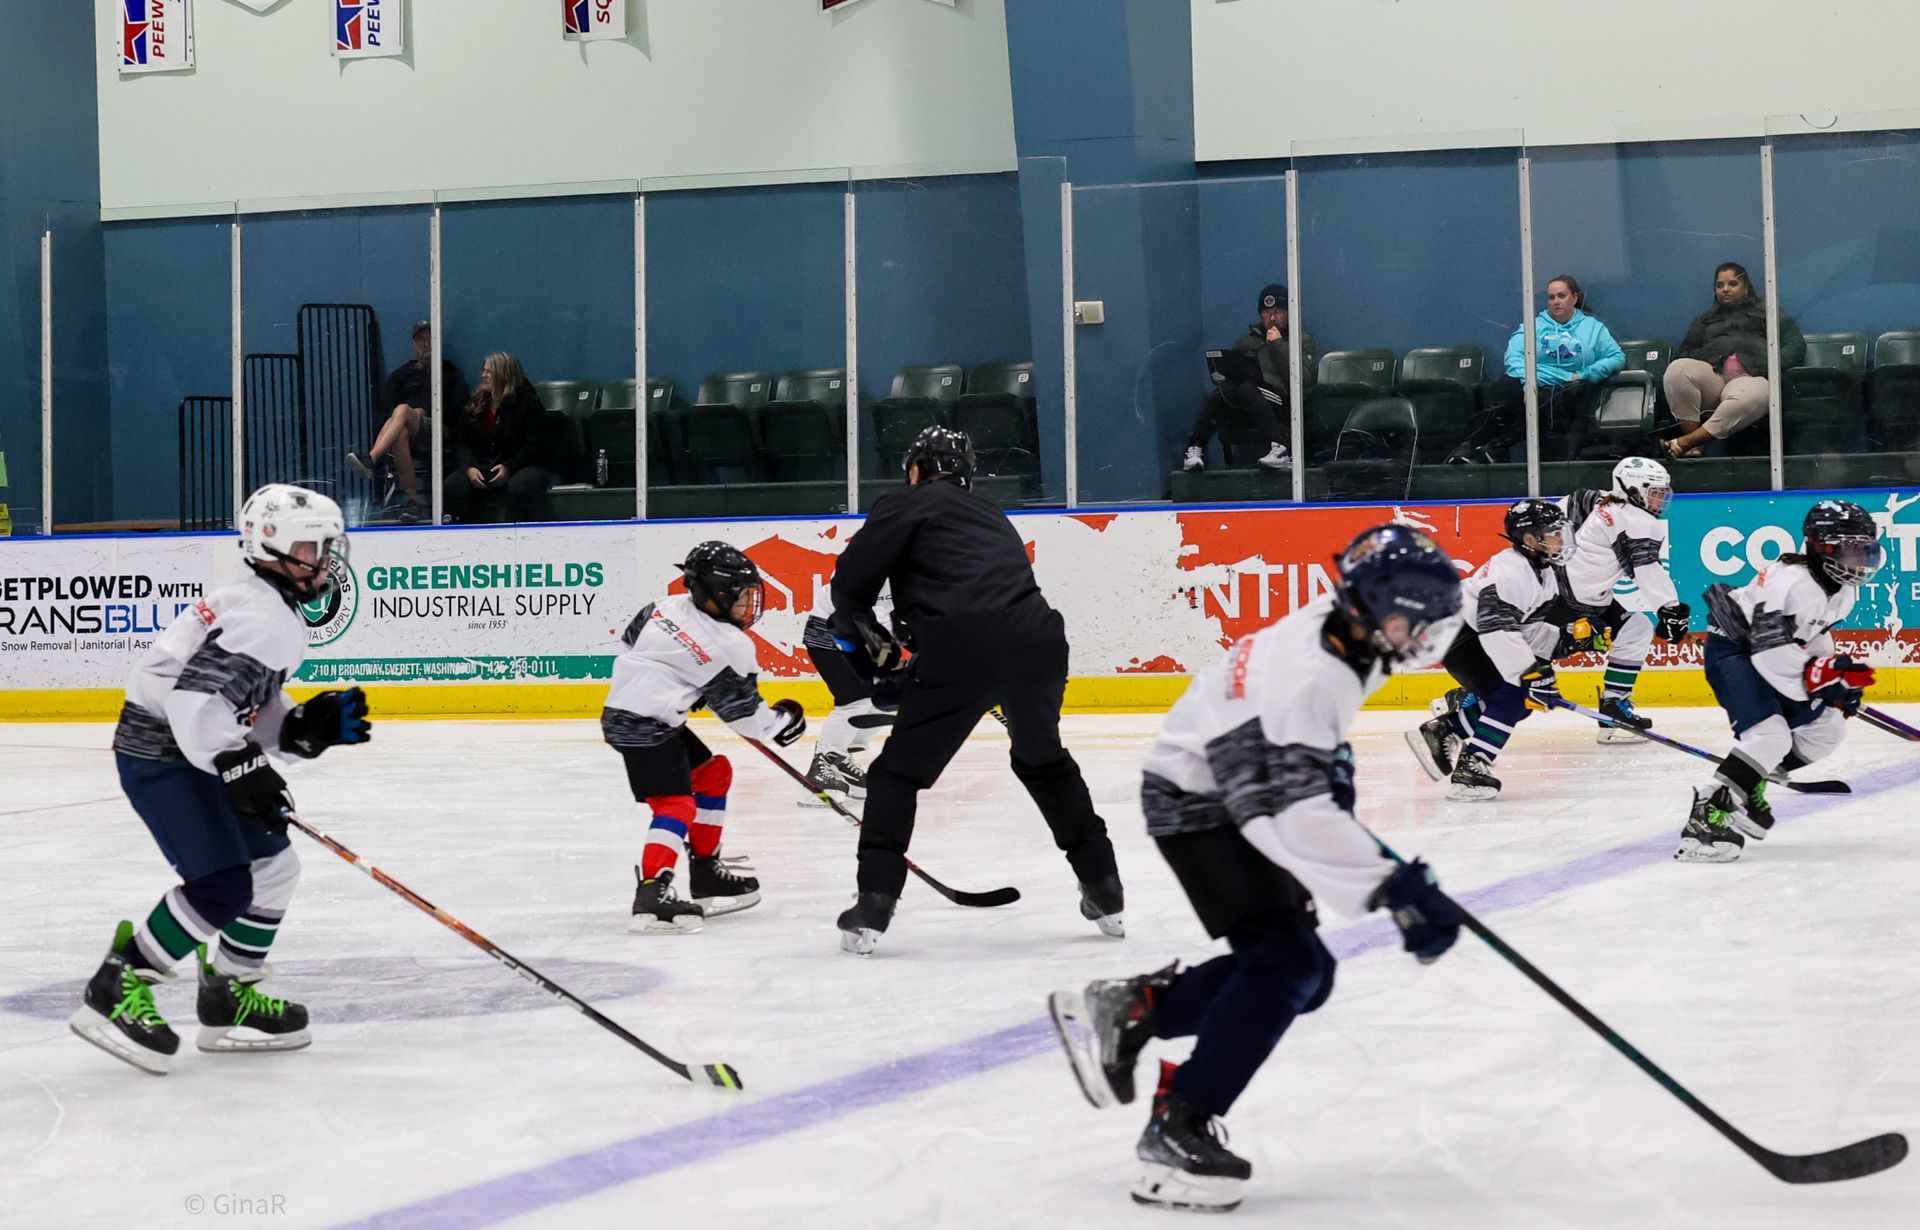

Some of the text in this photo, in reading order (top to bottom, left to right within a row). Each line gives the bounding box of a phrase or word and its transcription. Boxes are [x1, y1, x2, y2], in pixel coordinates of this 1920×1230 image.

[0, 575, 203, 600] ETPLOWED WITH
[366, 562, 604, 591] GREENSHIELDS
[1855, 582, 1900, 602] ITY
[373, 593, 596, 618] INDUSTRIAL SUPPLY
[0, 603, 190, 635] RANSBLU
[468, 619, 506, 629] since 1953
[1, 641, 28, 651] Snow
[30, 640, 72, 650] Removal
[80, 639, 126, 650] Janitorial
[1647, 643, 1704, 659] ALBAN
[331, 664, 337, 676] N
[423, 661, 477, 675] WASHINON
[222, 754, 269, 783] BAUE
